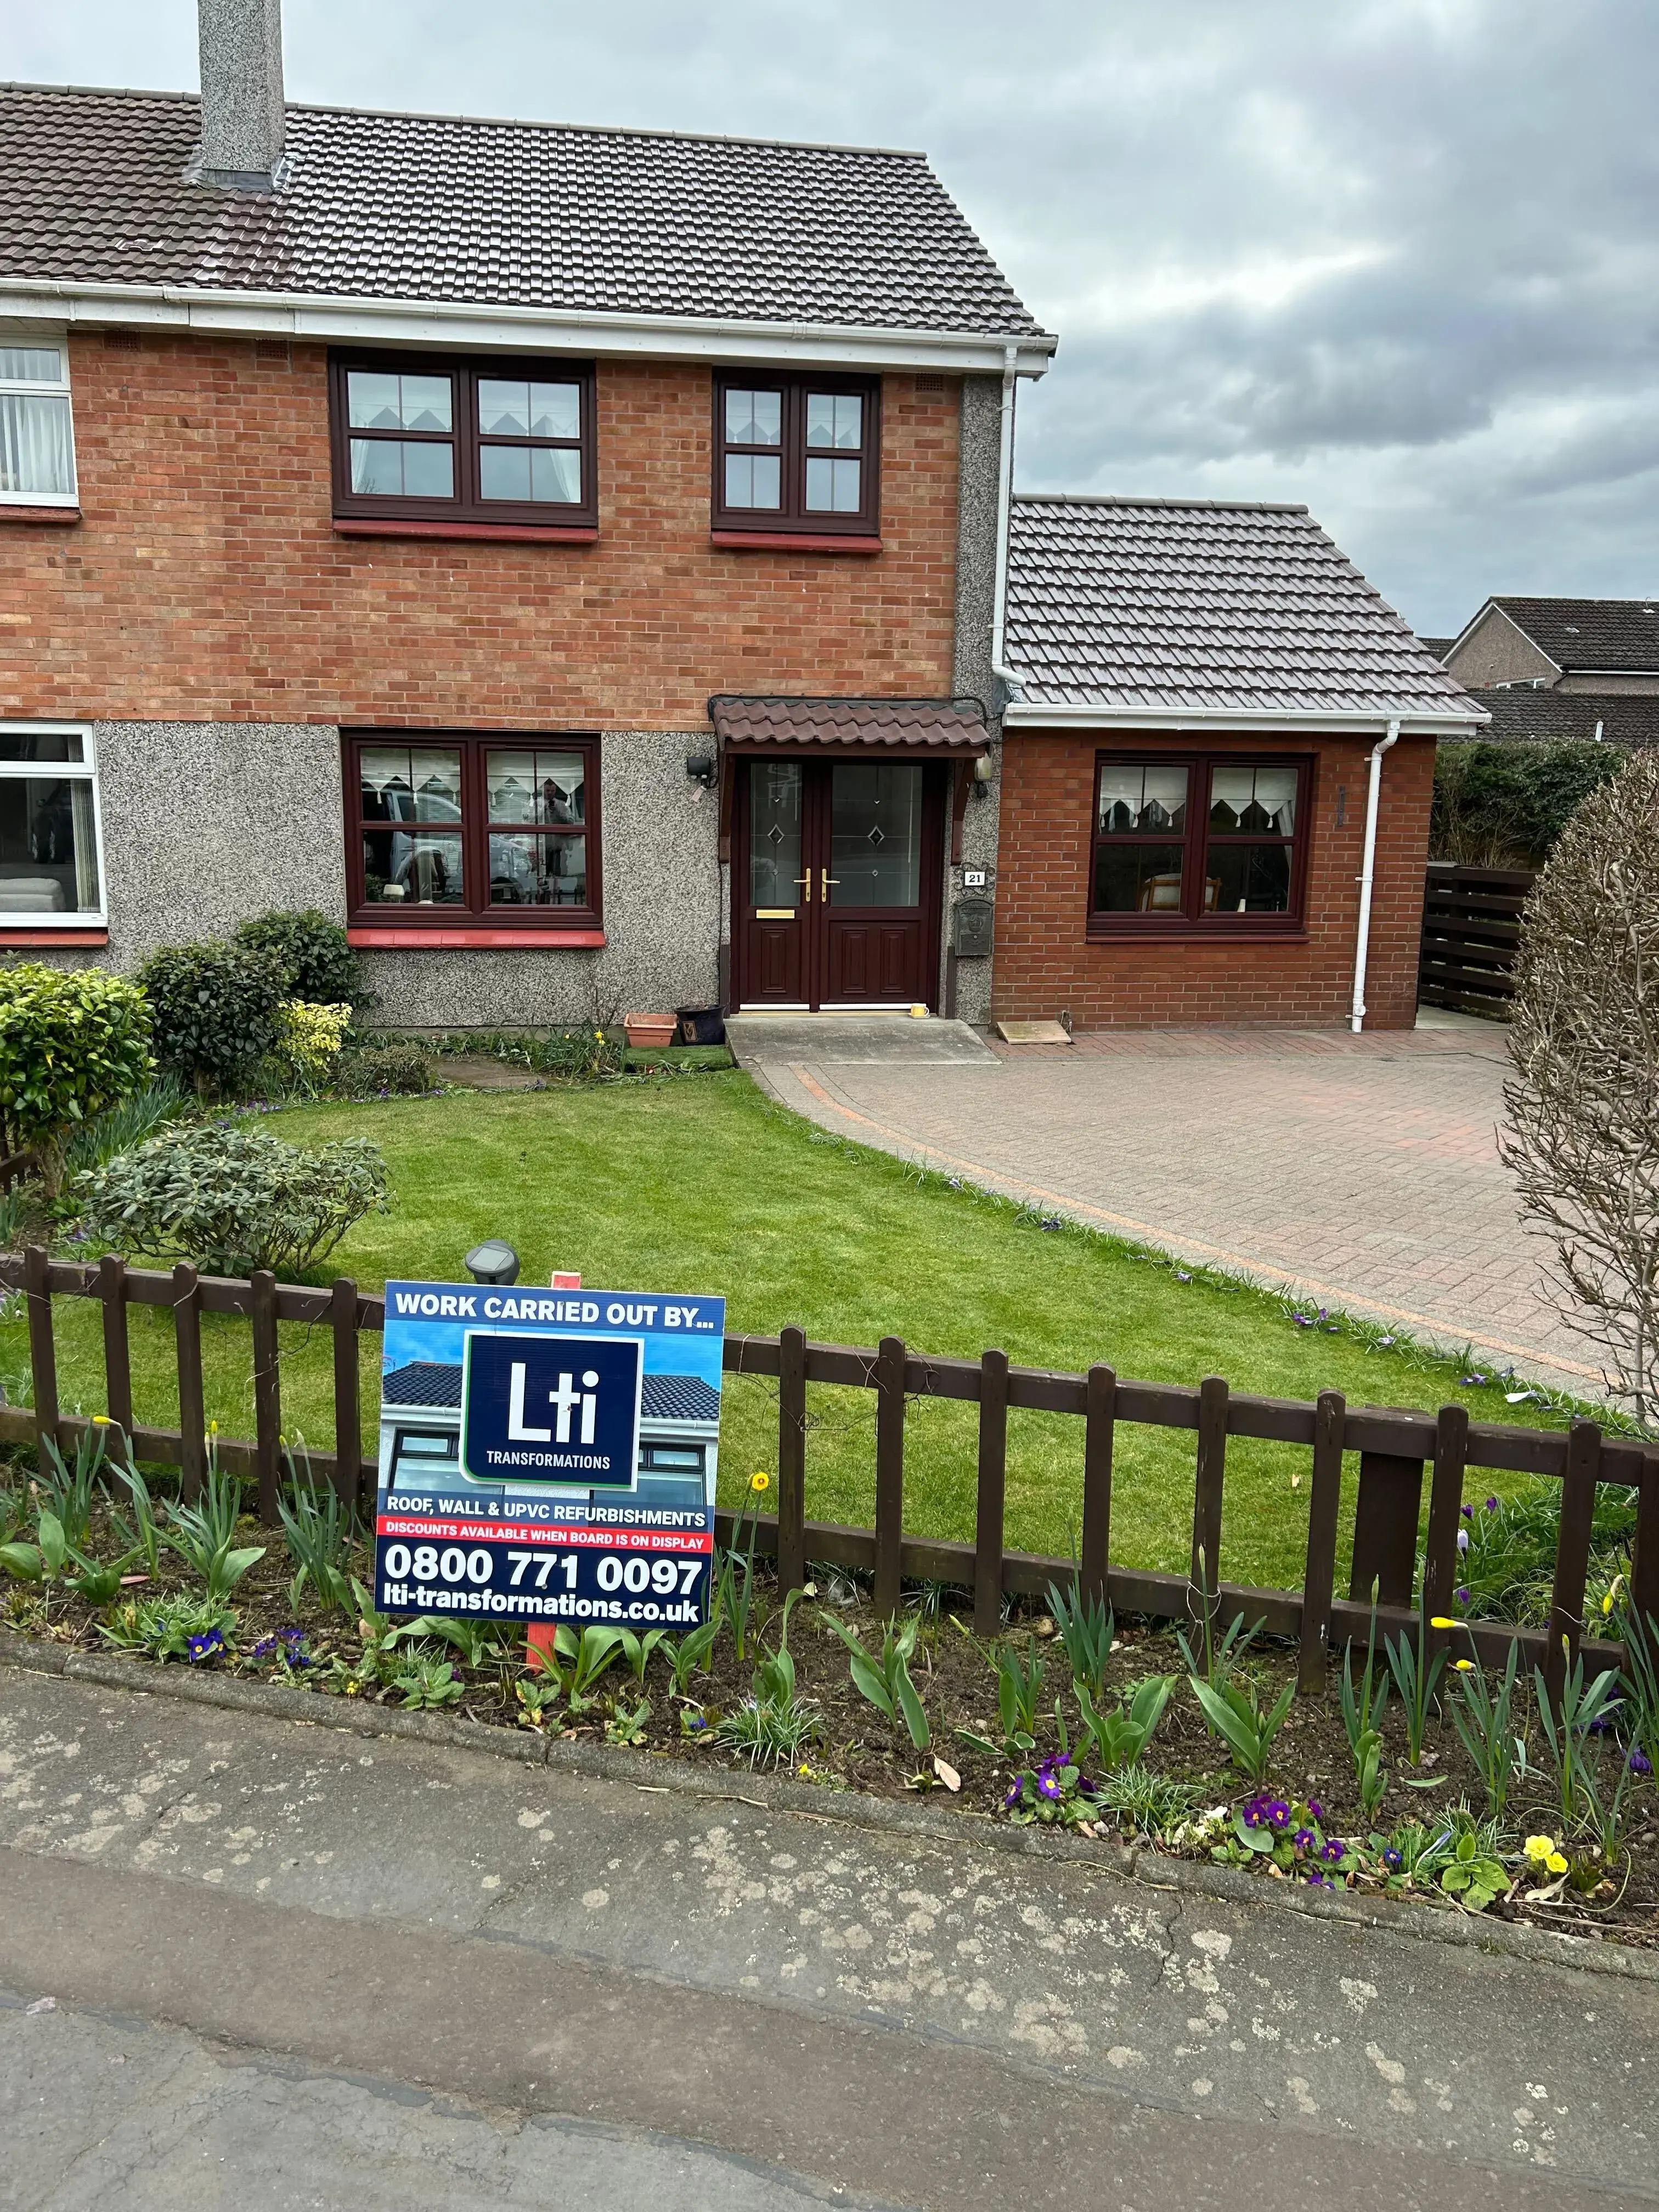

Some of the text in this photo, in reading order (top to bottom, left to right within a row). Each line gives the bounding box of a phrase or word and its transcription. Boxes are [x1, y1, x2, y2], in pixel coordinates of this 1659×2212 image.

[969, 874, 981, 883] 21
[395, 1293, 714, 1329] WORK CARRIED OUT BY...
[508, 1362, 599, 1444] Lti
[487, 1451, 610, 1469] TRANSFORMATIONS
[387, 1496, 706, 1527] ROOF, WALL & UPVC REFURBISHMENTS
[386, 1521, 704, 1549] DISCOUNTS AVAILABLE WHEN BOARD IS ON DISPLAY
[385, 1544, 702, 1595] 0800 771 0097
[383, 1582, 699, 1622] lti-transformations.co.uk
